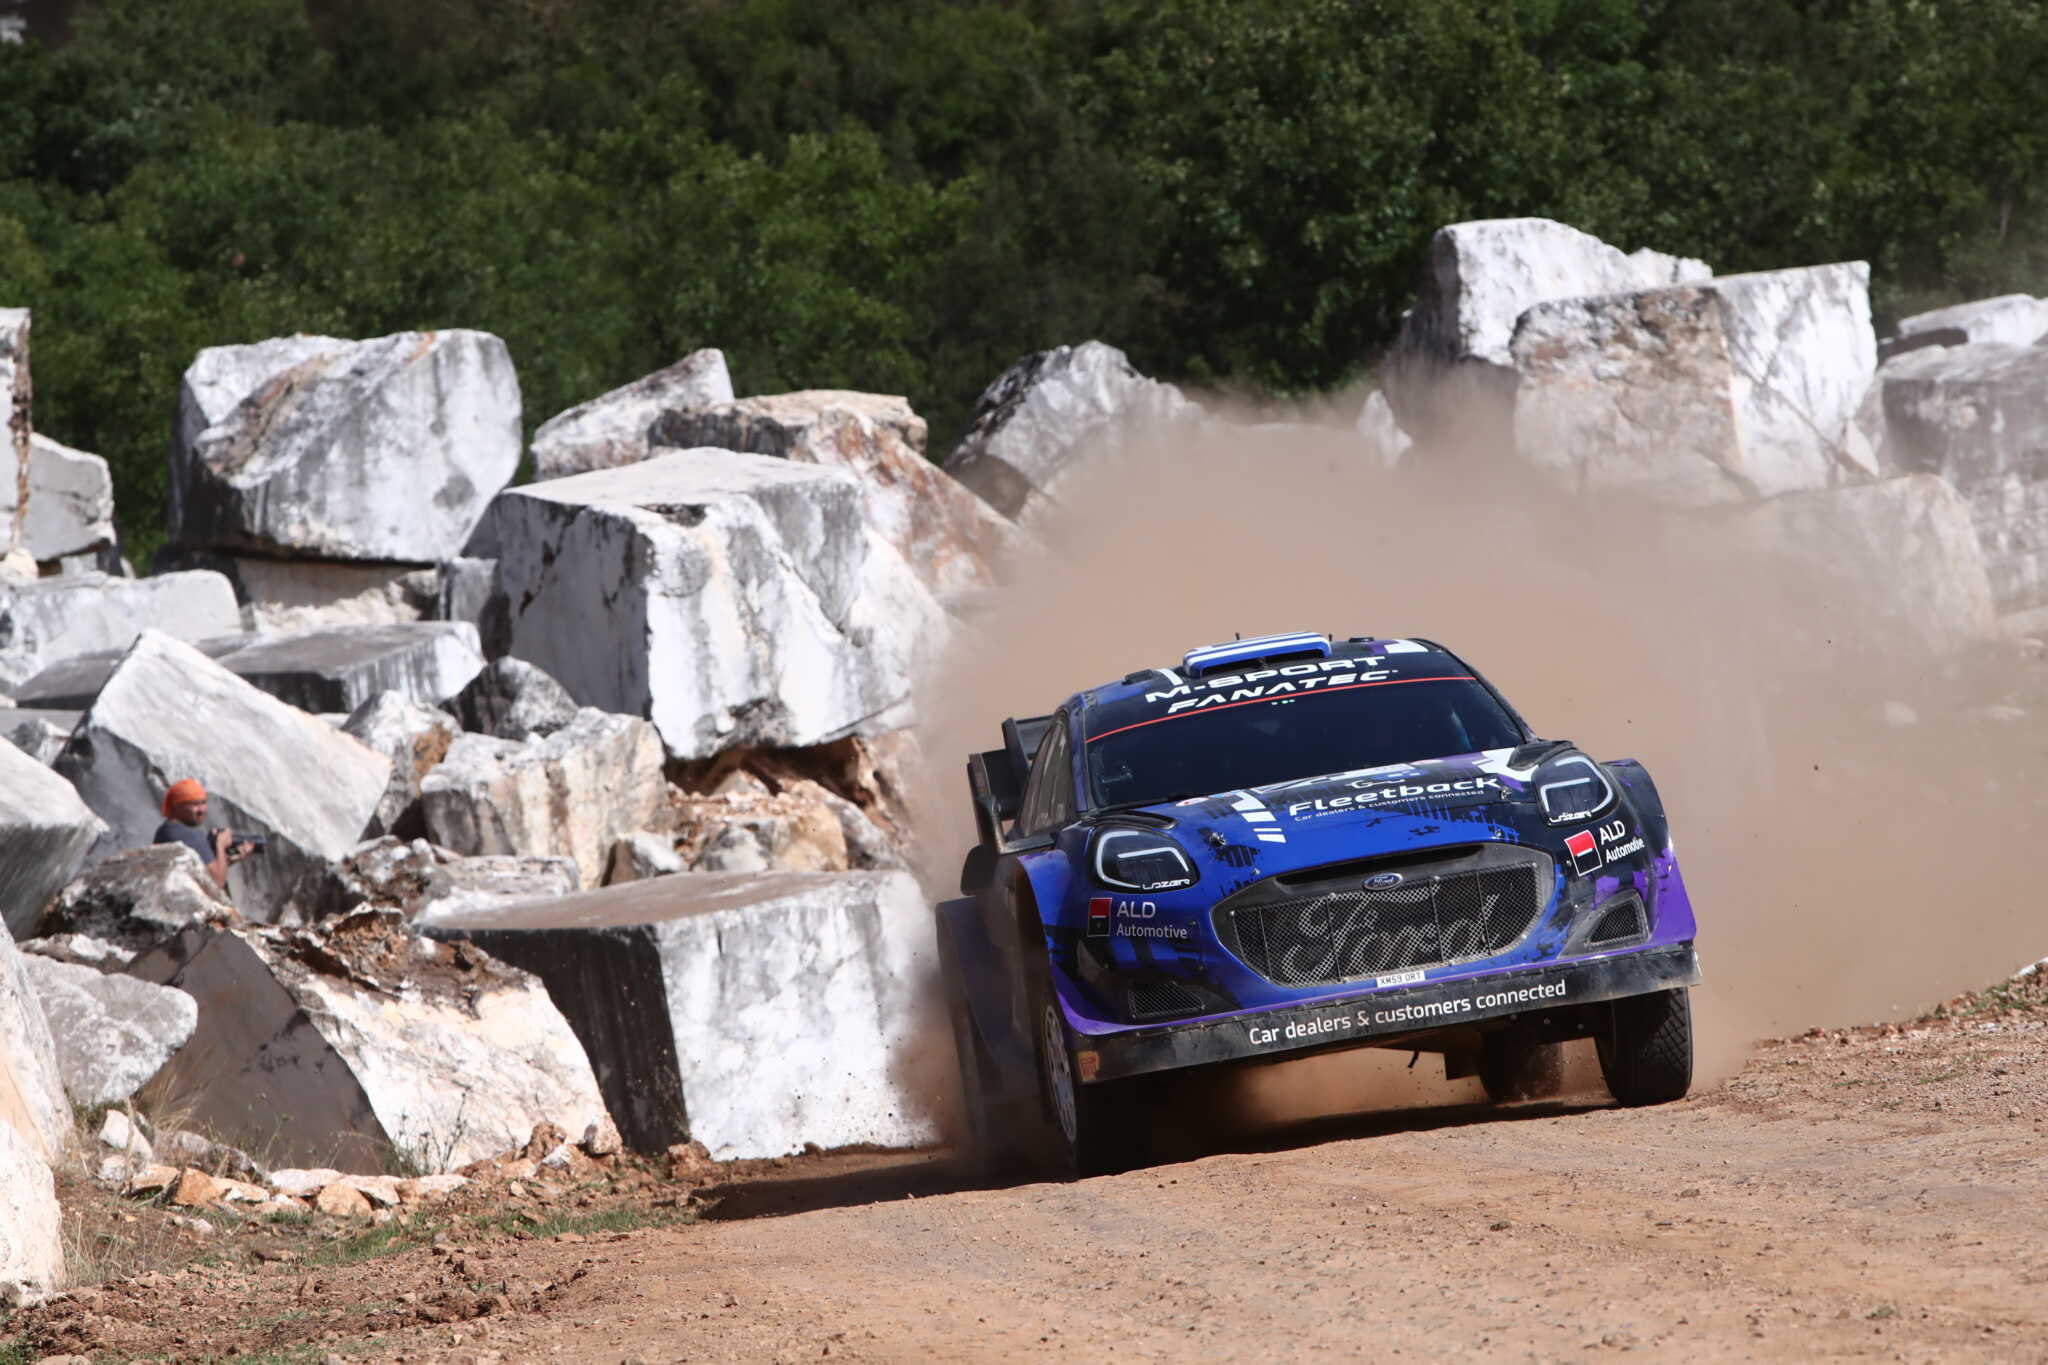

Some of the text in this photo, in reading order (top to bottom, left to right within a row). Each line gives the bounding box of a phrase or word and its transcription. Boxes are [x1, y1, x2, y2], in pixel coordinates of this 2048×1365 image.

[1145, 656, 1386, 703] M-SPORT
[1167, 670, 1395, 714] FANATEC
[1289, 777, 1500, 816] Fleetback
[1294, 814, 1313, 822] Car
[1315, 806, 1356, 817] dealers
[1368, 796, 1426, 808] customers
[1428, 789, 1485, 800] connected
[1599, 820, 1626, 846] ALD
[1116, 900, 1157, 919] ALD
[1116, 923, 1188, 940] Automotive
[1280, 886, 1501, 986] Ford
[1249, 979, 1567, 1046] Car dealers & customers connected
